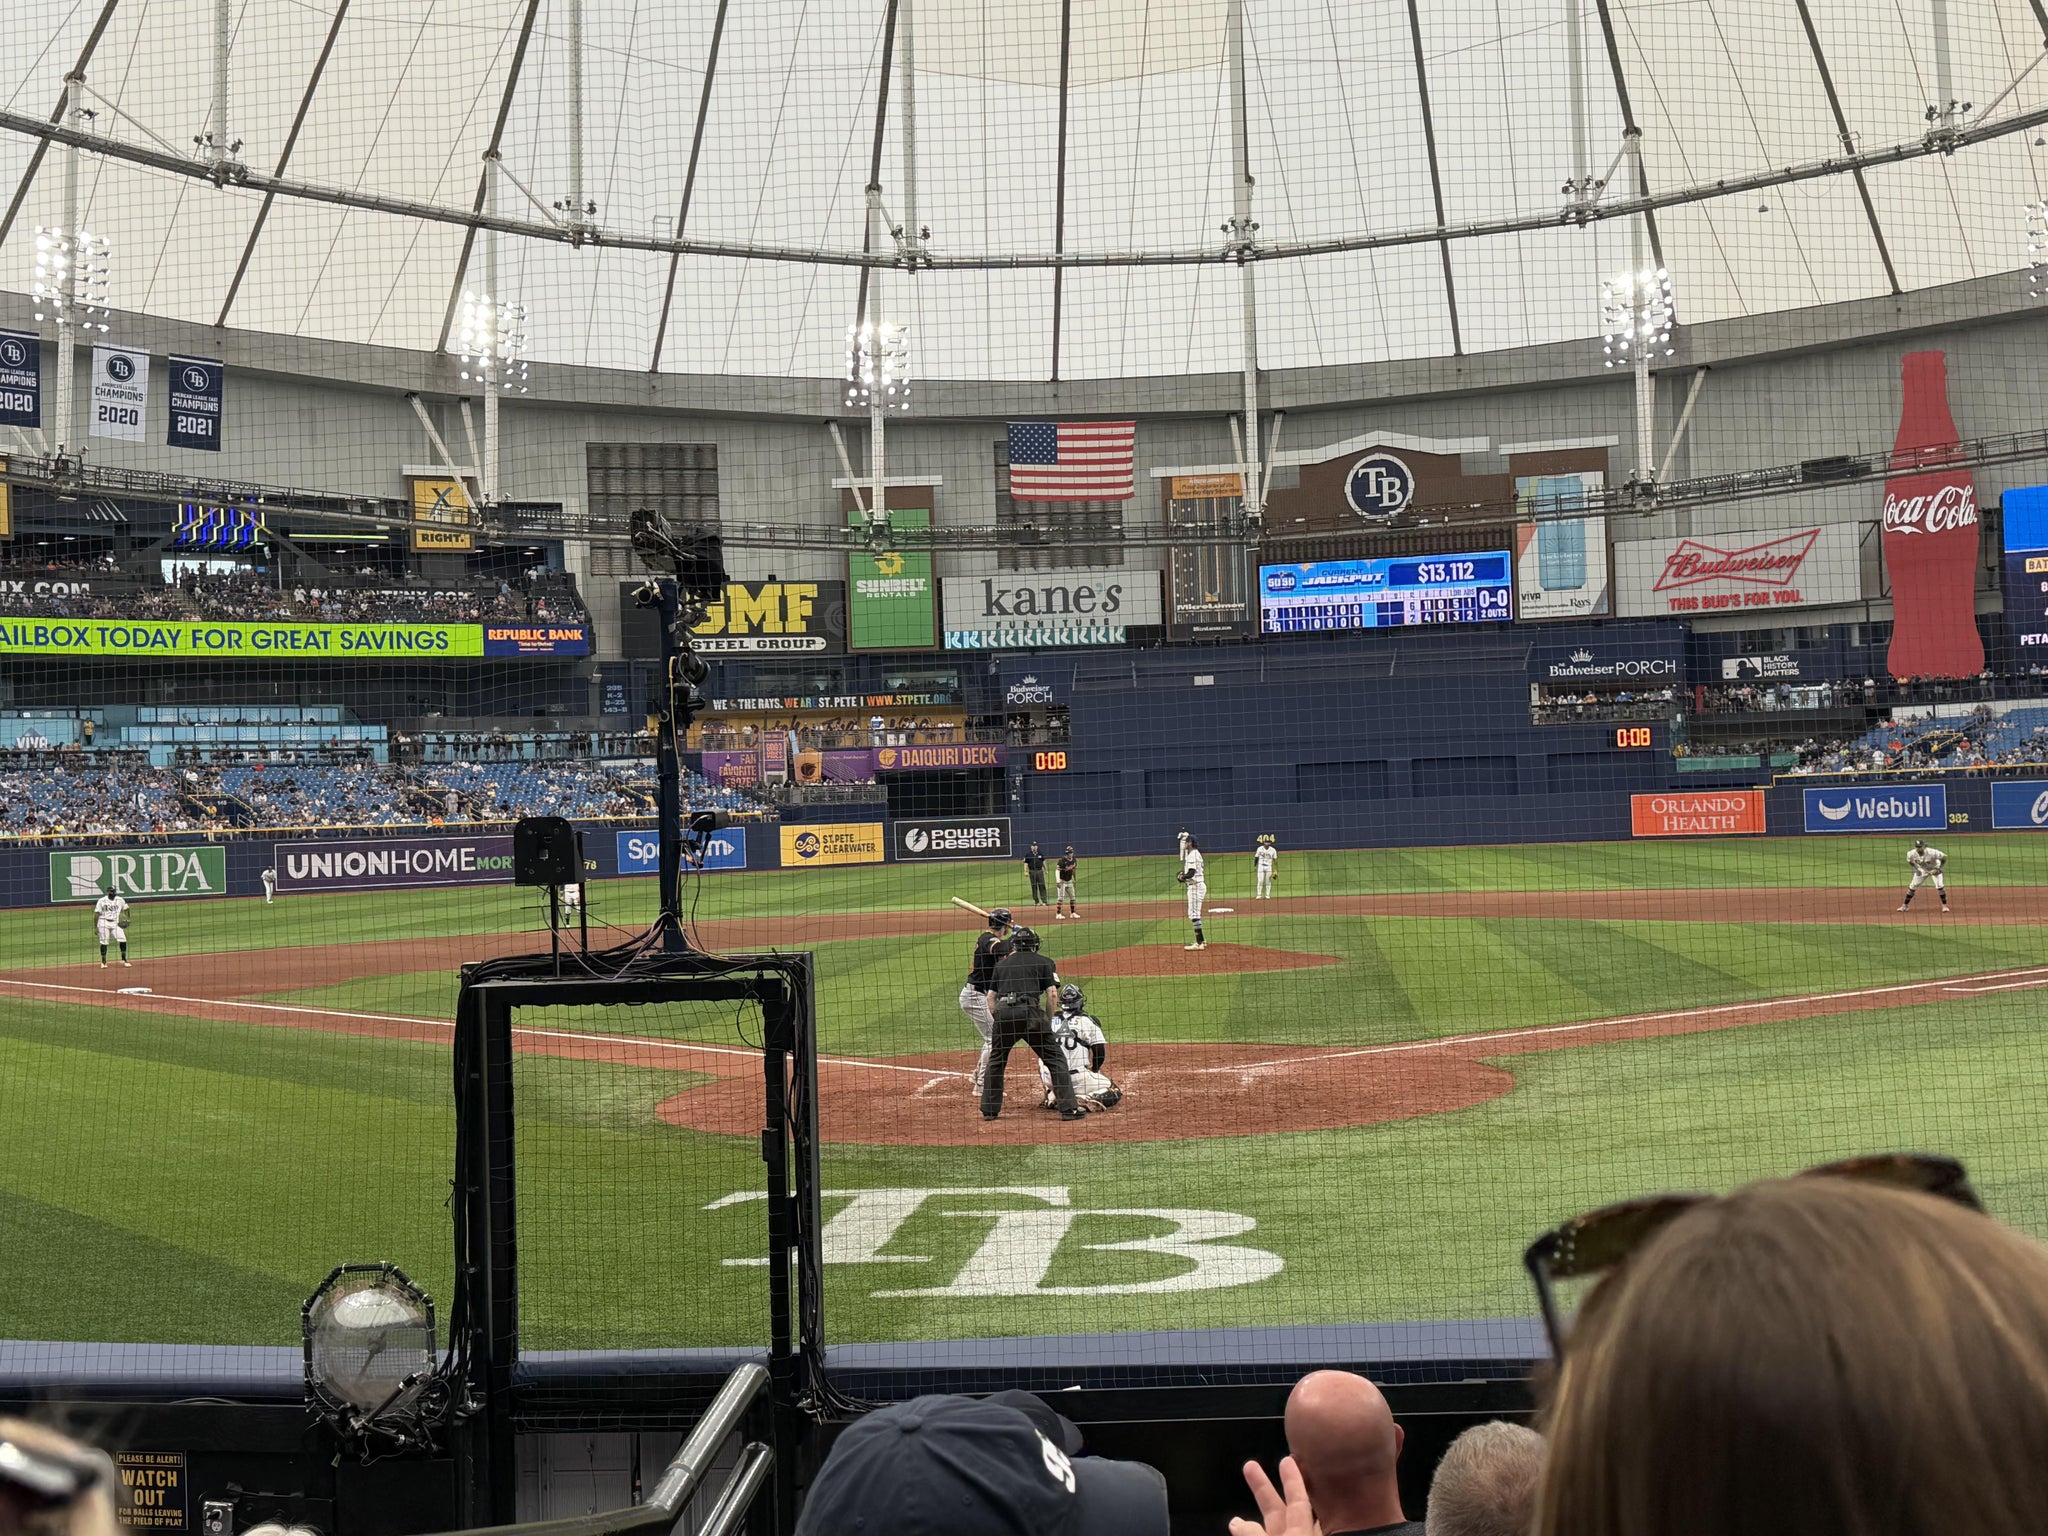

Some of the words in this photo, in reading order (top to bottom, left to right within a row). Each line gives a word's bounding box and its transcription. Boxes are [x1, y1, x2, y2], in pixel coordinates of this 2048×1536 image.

[113, 360, 129, 377] TB
[188, 371, 204, 387] TB
[95, 386, 144, 402] CHAMPIONS
[171, 397, 219, 412] CHAMPIONS
[98, 405, 139, 426] 2020
[177, 416, 213, 436] 2021
[1358, 467, 1403, 507] TB
[1884, 485, 1977, 534] Coca-Cola
[421, 533, 465, 543] RIGHT.
[1418, 562, 1475, 583] $13,112
[1667, 551, 1803, 578] Budweiser
[856, 578, 926, 593] SUNBELT
[1302, 573, 1385, 588] JACKPOT
[981, 578, 1122, 616] kane's
[1480, 589, 1508, 607] 0-0
[1669, 597, 1699, 611] THIS
[1702, 593, 1741, 609] BUD'S
[1744, 592, 1770, 606] FOR
[1773, 589, 1804, 604] YOU.
[1327, 606, 1333, 616] 3
[1424, 612, 1431, 622] 4
[1453, 611, 1460, 621] 3
[1467, 610, 1473, 620] 2
[1481, 609, 1486, 618] 2
[1487, 608, 1508, 618] OUTS
[996, 618, 1109, 630] FURNITURE
[97, 626, 182, 649] TODAY
[191, 629, 243, 649] FOR
[251, 628, 332, 650] GREAT
[340, 630, 449, 651] SAVINGS
[488, 629, 546, 640] REPUBLIC
[548, 629, 583, 640] BANK
[692, 639, 750, 650] STEEL
[757, 638, 817, 649] GROUP
[1763, 655, 1790, 663] BLACK
[1763, 661, 1799, 670] HISTORY
[1549, 664, 1614, 677] Budweiser
[1616, 660, 1676, 676] PORCH
[1763, 669, 1800, 677] MATTERS
[1010, 684, 1050, 693] Budweiser
[713, 699, 728, 710] WE
[737, 698, 757, 709] THE
[758, 697, 783, 709] RAYS.
[784, 697, 798, 708] WE
[800, 697, 817, 708] ARE
[818, 697, 833, 708] ST.
[834, 696, 857, 707] PETE
[866, 694, 952, 707] WWW.STPETE.ORG
[1007, 691, 1053, 704] PORCH
[1616, 727, 1651, 748] 0:08
[901, 748, 959, 767] DAIQUIRI
[962, 746, 998, 764] DECK
[1035, 752, 1067, 770] 0:08
[1651, 797, 1746, 814] ORLANDO
[1855, 796, 1931, 819] Webull
[1663, 815, 1736, 831] HEALTH
[1949, 813, 1969, 823] 382
[823, 843, 876, 854] CLEARWATER
[107, 852, 213, 894] RIPA
[584, 860, 597, 870] 78
[118, 1454, 144, 1463] PLEASE
[146, 1455, 155, 1463] BE
[156, 1455, 180, 1464] ALERT!
[121, 1469, 178, 1488] WATCH
[133, 1489, 166, 1506] OUT
[119, 1507, 132, 1516] FOR
[133, 1508, 153, 1517] BALLS
[154, 1509, 182, 1518] LEAVING
[118, 1516, 132, 1525] THE
[133, 1517, 153, 1526] FIELD
[154, 1518, 163, 1526] OF
[165, 1518, 183, 1527] PLAY
